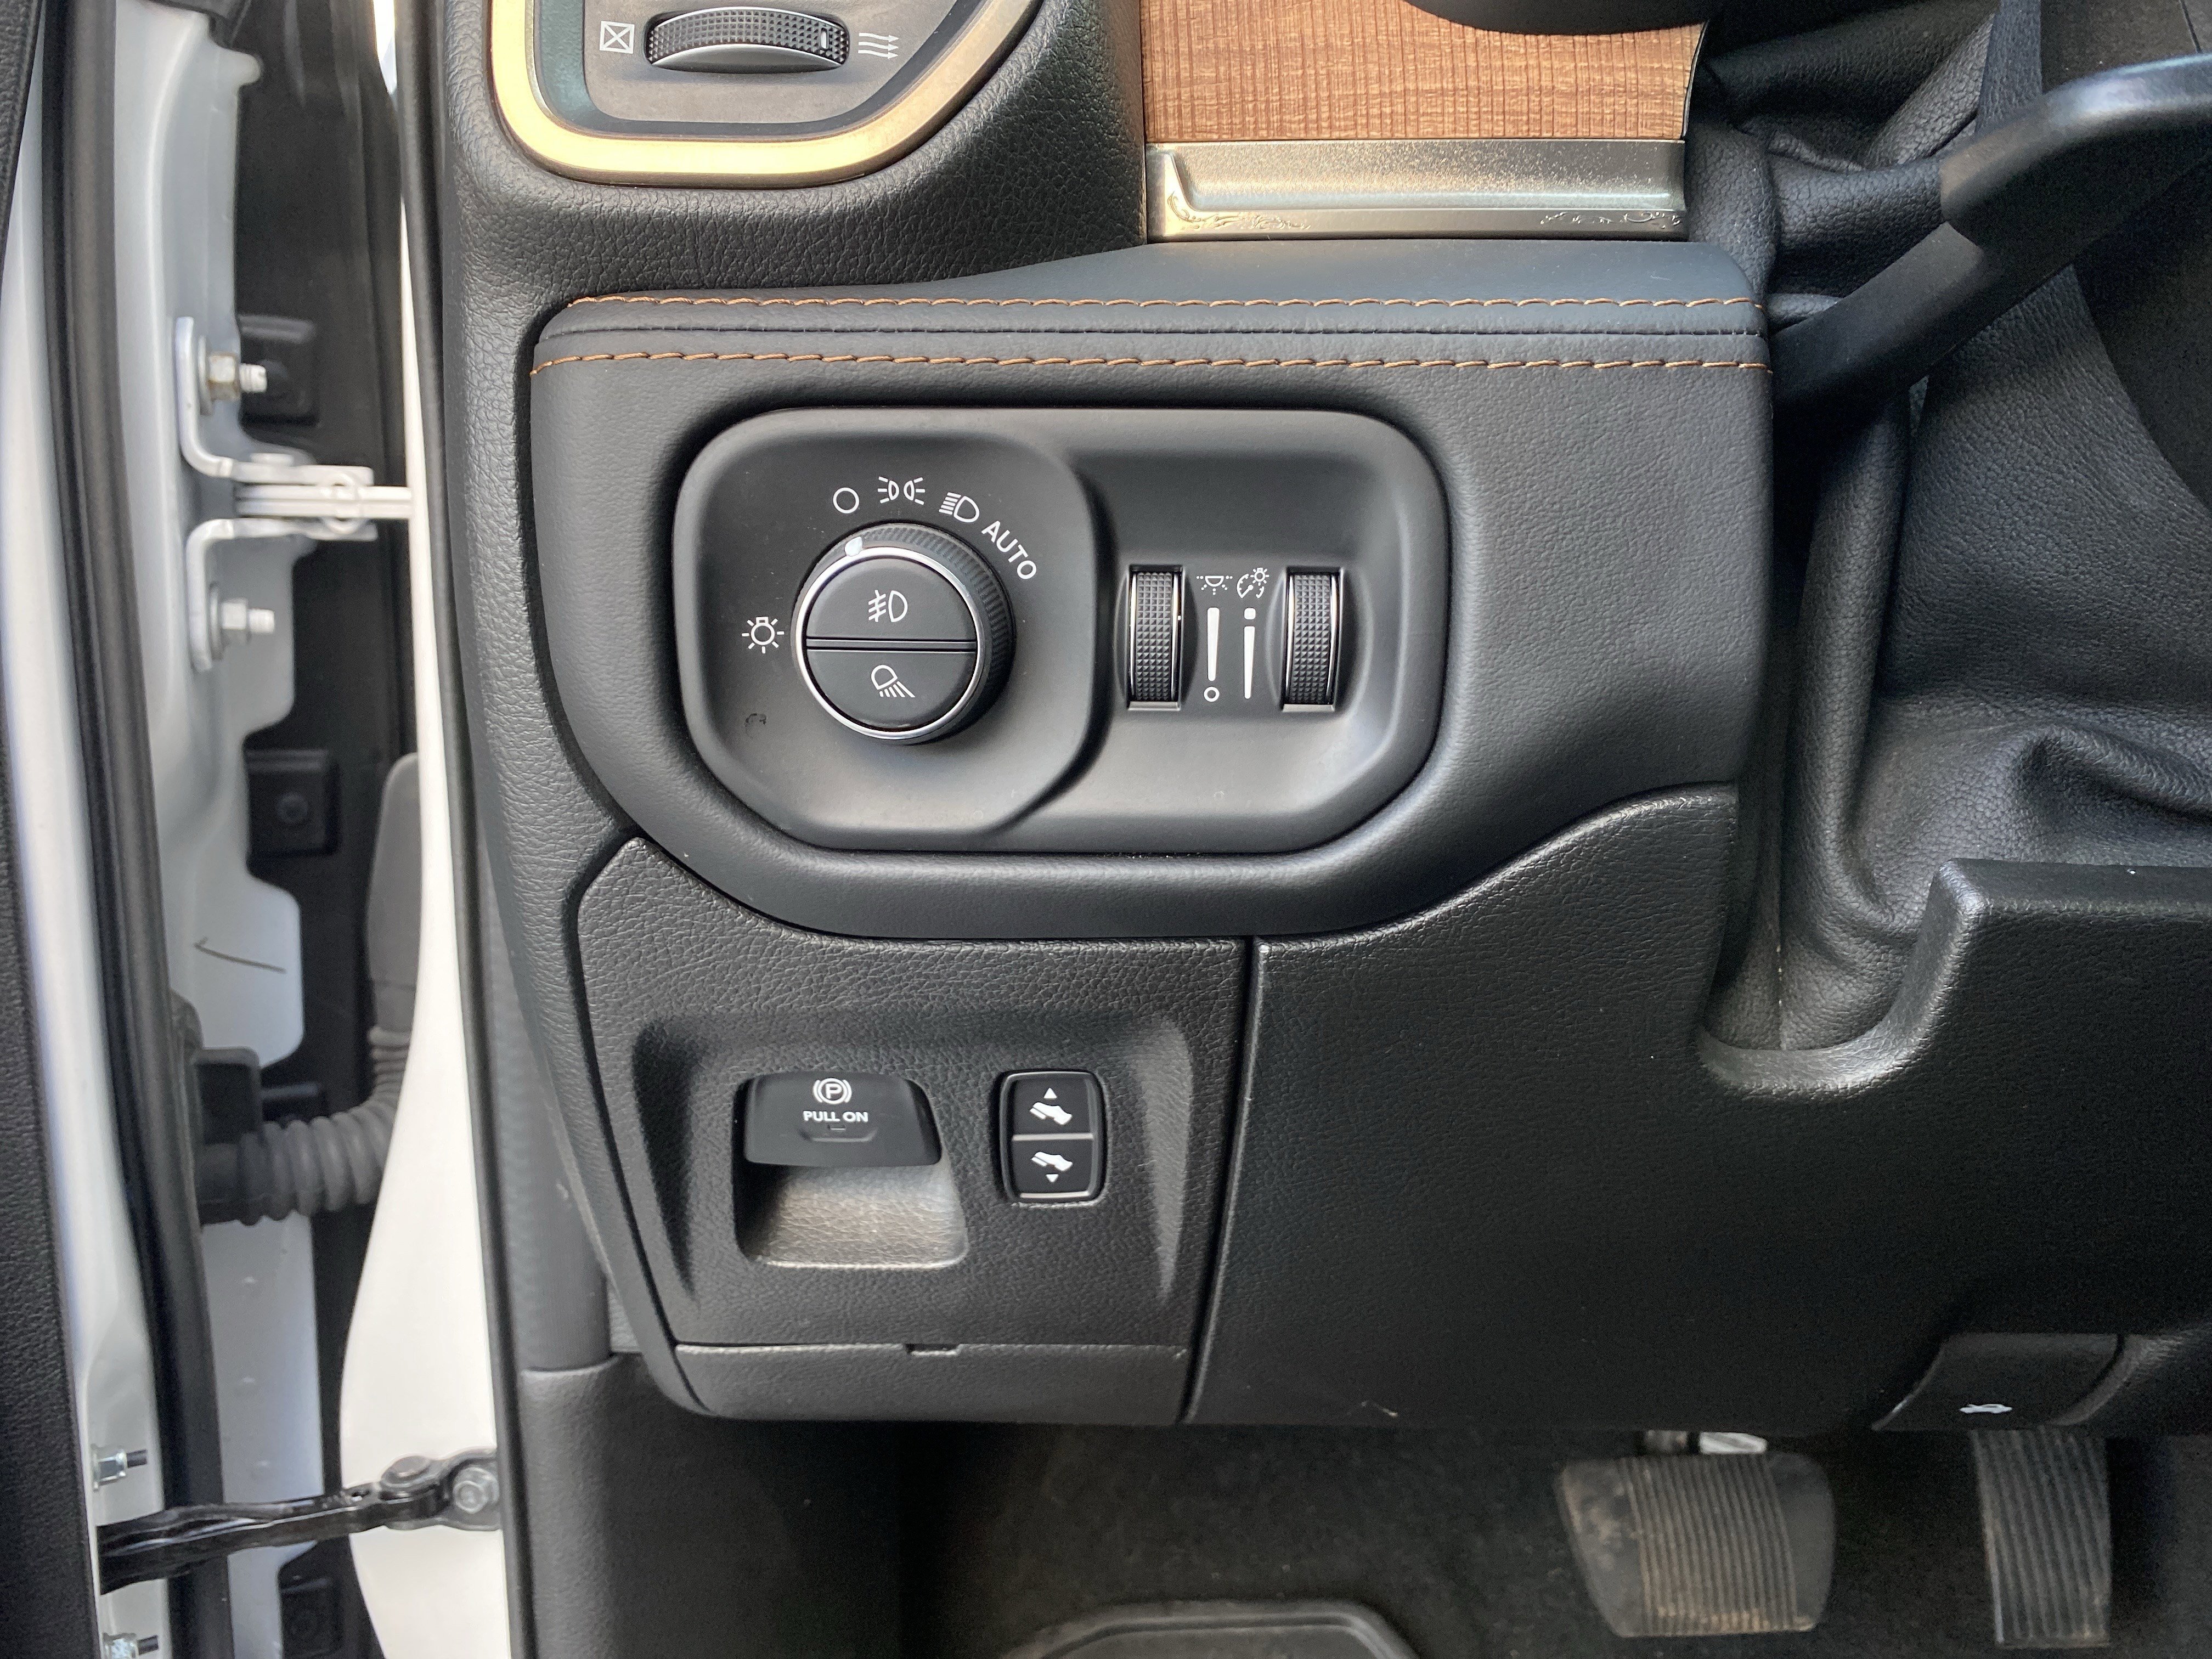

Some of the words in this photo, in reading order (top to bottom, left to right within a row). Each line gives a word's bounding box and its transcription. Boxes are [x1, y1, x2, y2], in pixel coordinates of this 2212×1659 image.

[981, 521, 1037, 579] AUTO
[803, 1110, 840, 1122] PULL
[842, 1110, 868, 1122] ON
